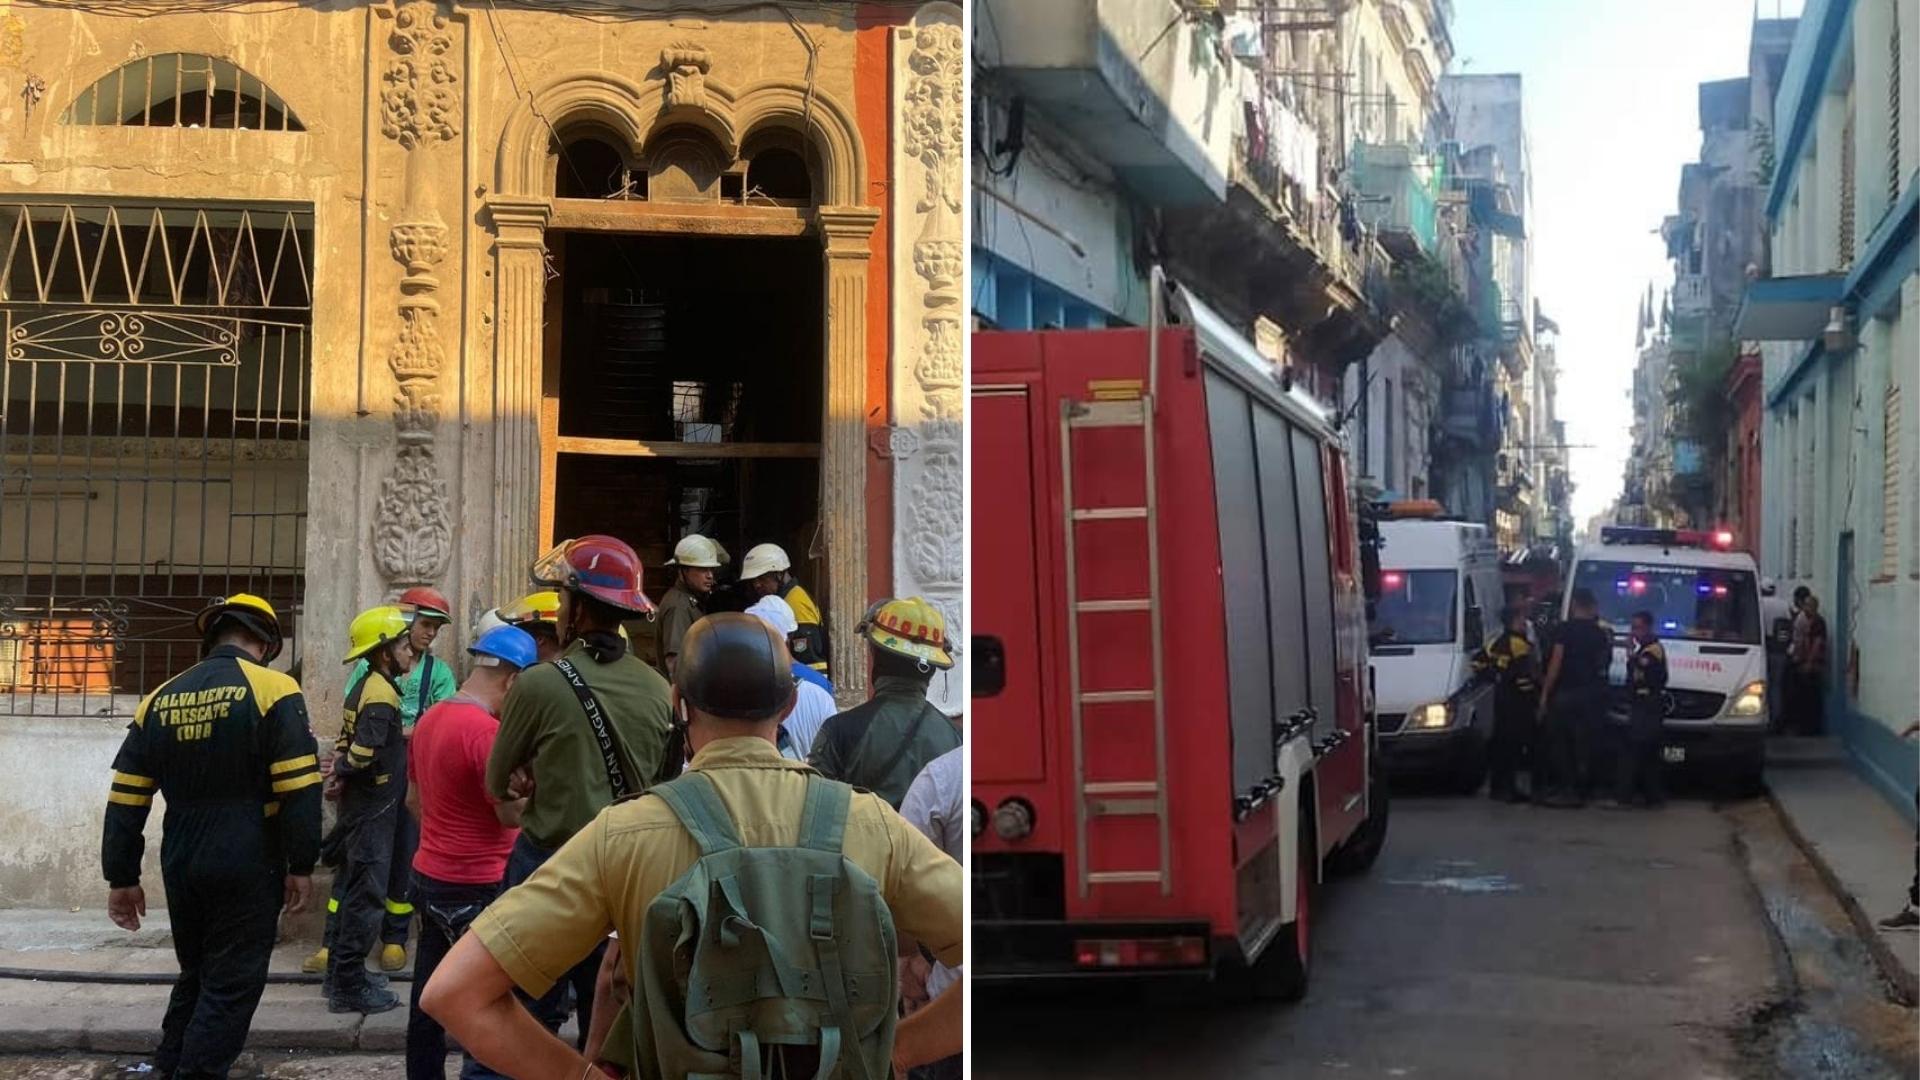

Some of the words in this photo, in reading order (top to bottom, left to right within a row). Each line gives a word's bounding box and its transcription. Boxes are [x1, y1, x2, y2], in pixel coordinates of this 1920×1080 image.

[153, 685, 247, 712] SALVAMENTO
[160, 710, 168, 727] Y
[170, 702, 231, 724] RESCATE
[583, 698, 612, 749] EAGLE
[176, 722, 212, 741] CUBA
